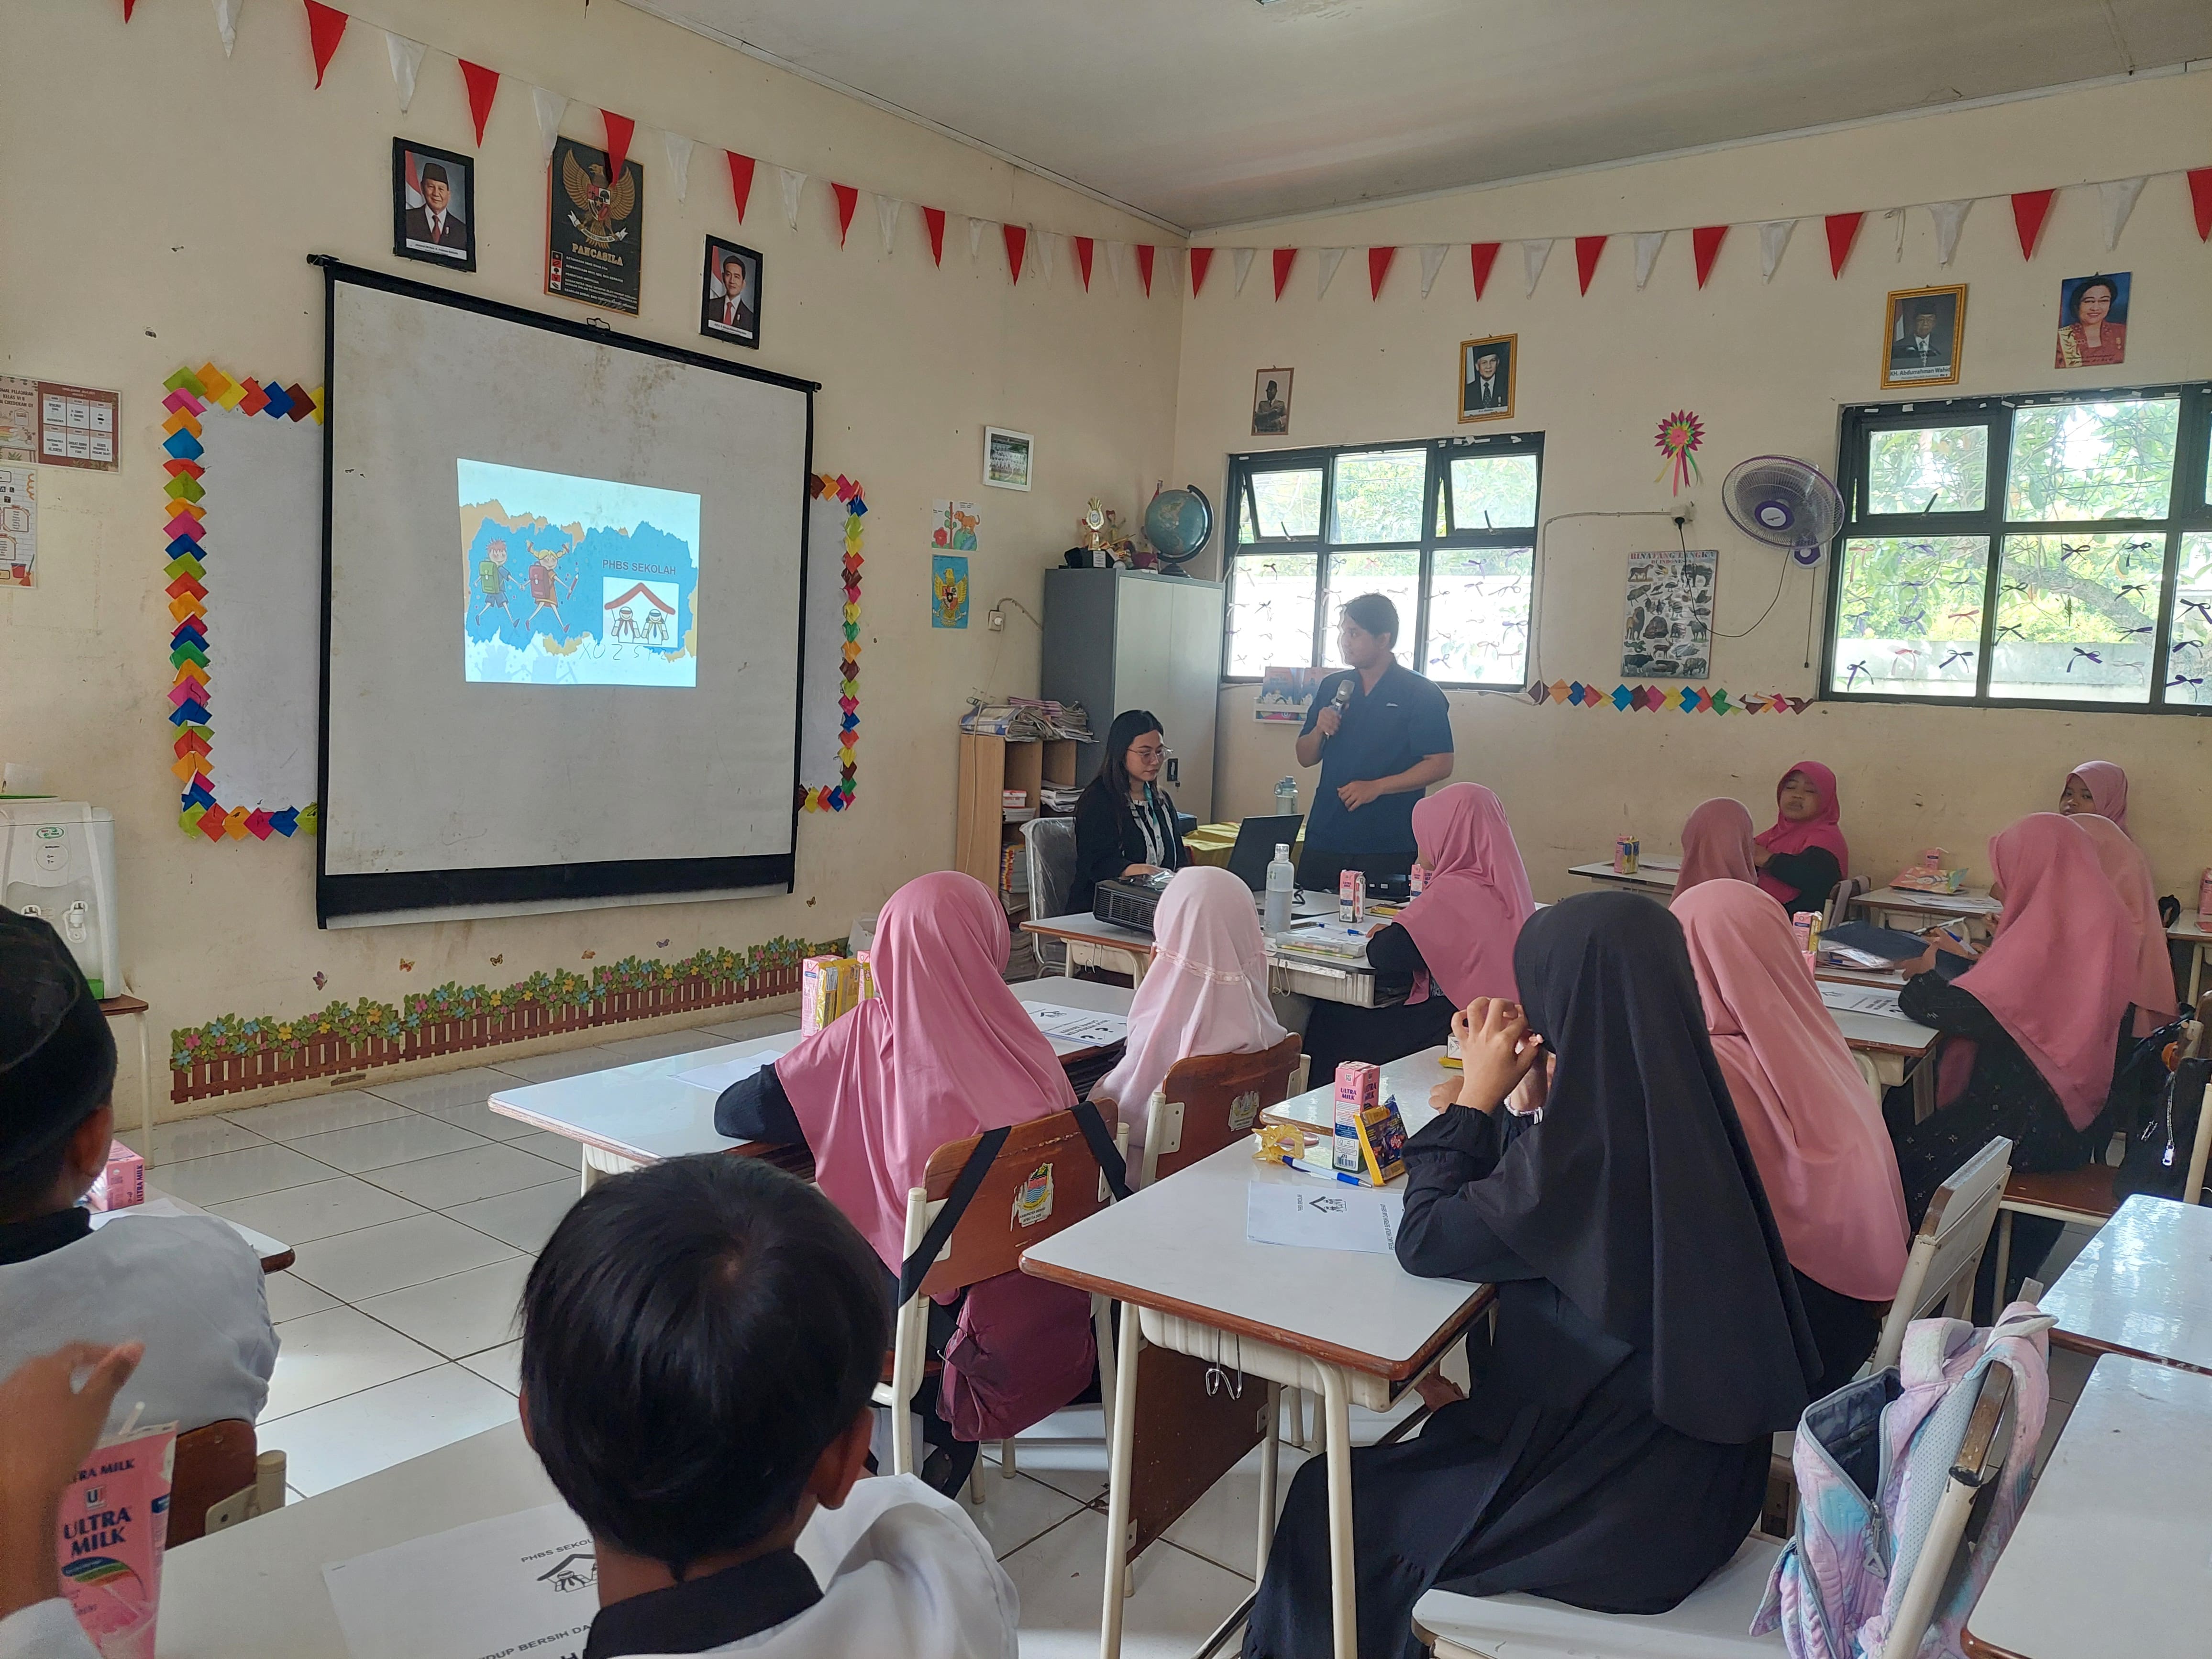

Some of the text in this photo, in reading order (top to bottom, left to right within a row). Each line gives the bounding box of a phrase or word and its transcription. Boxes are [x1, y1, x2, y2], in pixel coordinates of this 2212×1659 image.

[572, 243, 623, 266] PANCASILA
[603, 559, 676, 575] PHBS SEKOLAH
[1340, 1087, 1357, 1095] ULTRA
[100, 1458, 135, 1474] MILK
[64, 1507, 132, 1539] ULTRA
[71, 1526, 126, 1557] MILK
[521, 1539, 594, 1563] PHBS SEKOL
[518, 1631, 569, 1651] BERSIH
[572, 1624, 592, 1634] DA
